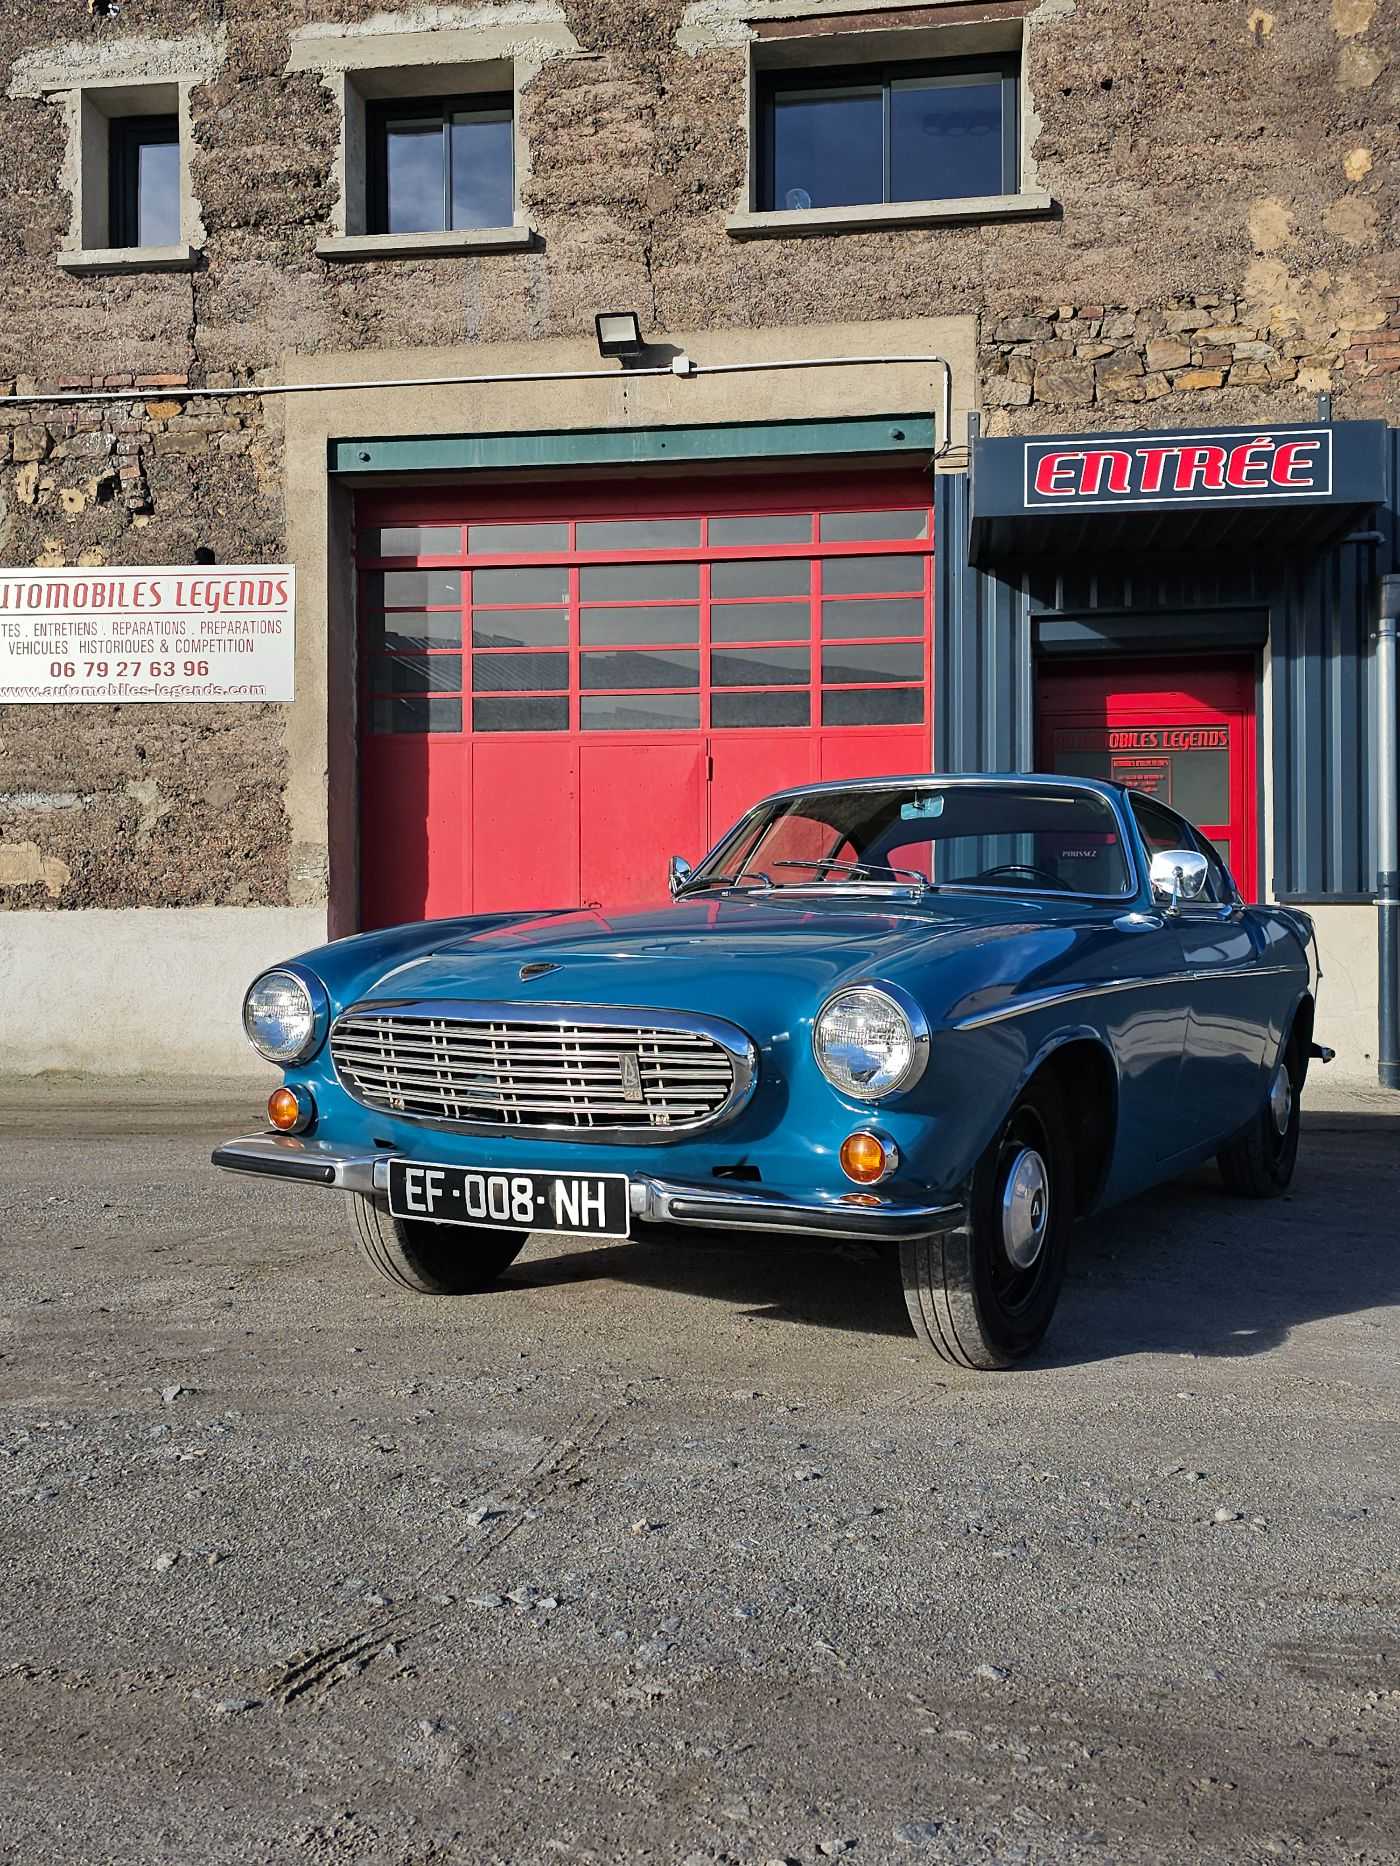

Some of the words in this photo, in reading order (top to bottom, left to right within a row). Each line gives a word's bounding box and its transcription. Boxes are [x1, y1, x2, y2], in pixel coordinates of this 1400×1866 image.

[1034, 437, 1321, 496] ENTRÉE
[175, 580, 288, 613] LEGENDS
[34, 621, 98, 637] ENTRETIENS
[112, 620, 186, 636] REPARATIONS
[200, 619, 282, 635] PREPARATIONS
[8, 640, 69, 655] VEHICULES
[79, 638, 154, 654] HISTORIQUES
[160, 638, 169, 653] &
[175, 638, 255, 654] COMPETITION
[50, 661, 76, 678] 06
[83, 661, 109, 678] 79
[116, 661, 142, 677] 27
[150, 661, 175, 677] 63
[183, 660, 209, 677] 96
[0, 682, 266, 698] www.automobiles-legends.com
[1109, 732, 1158, 749] OBILES
[1162, 730, 1228, 750] LEGENDS
